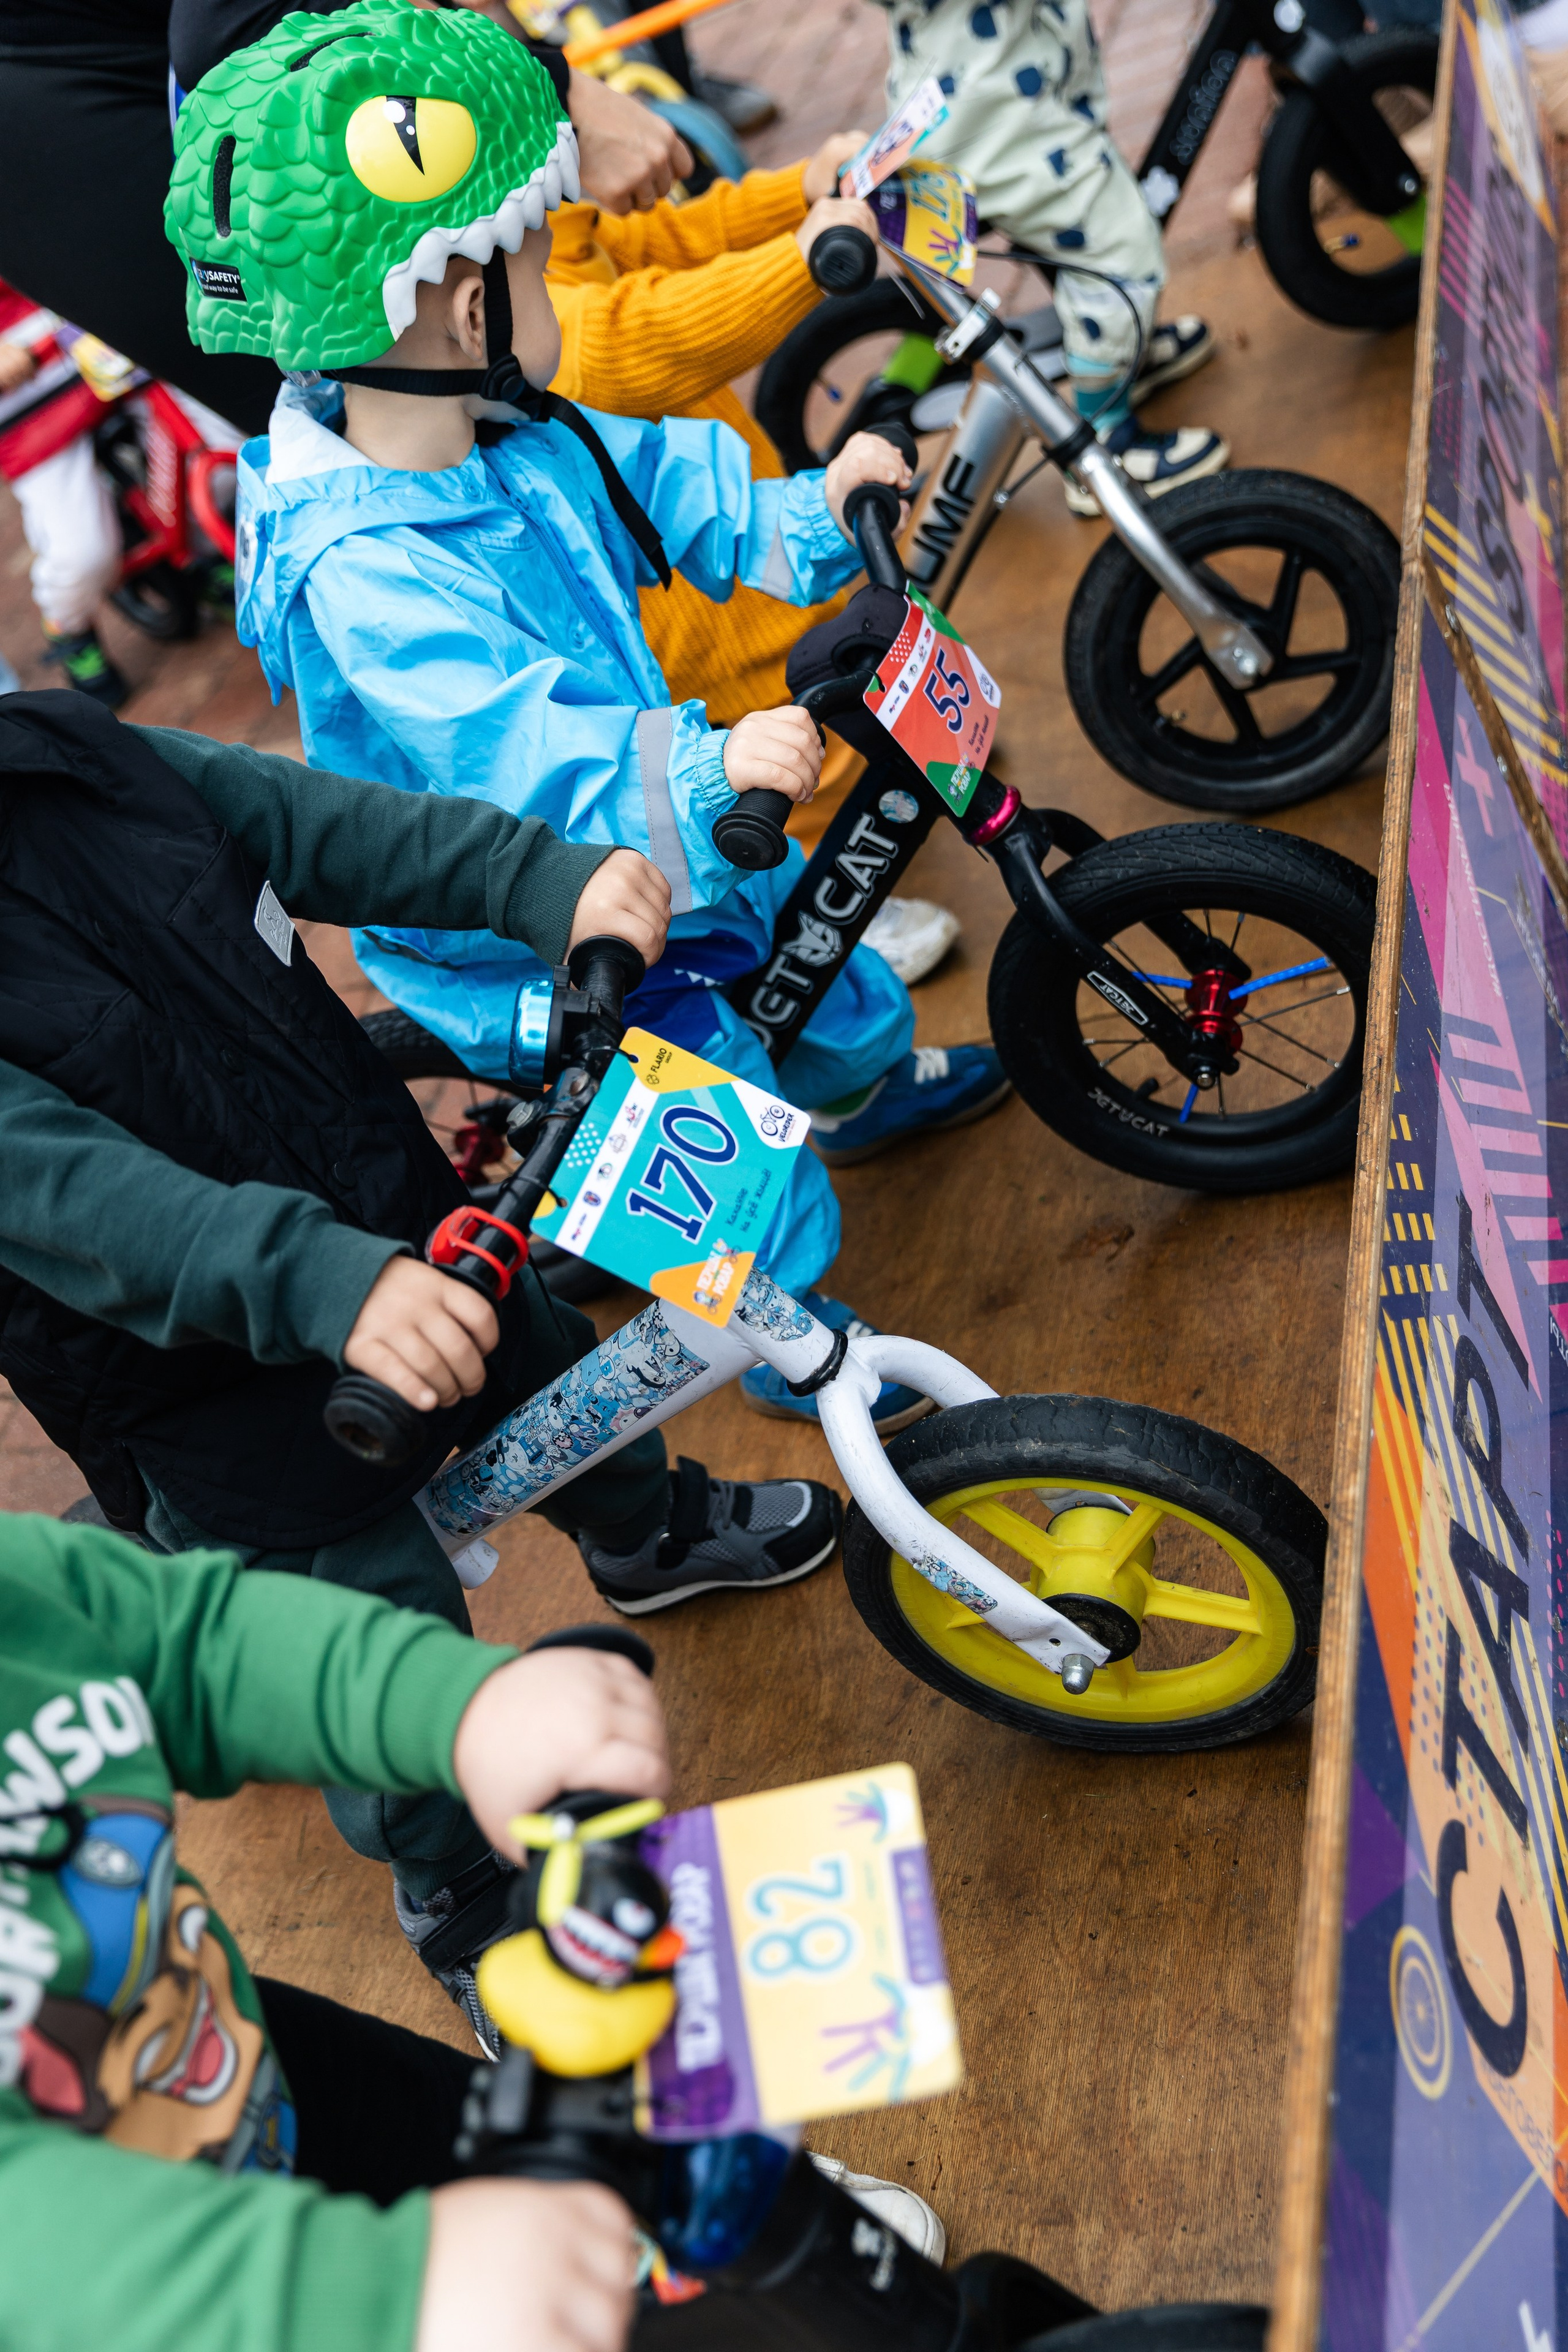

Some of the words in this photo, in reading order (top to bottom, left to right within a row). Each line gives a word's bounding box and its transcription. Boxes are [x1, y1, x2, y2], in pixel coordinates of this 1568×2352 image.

[923, 647, 970, 734] 55
[650, 1047, 667, 1074] FLARIO
[627, 1105, 738, 1243] 170
[778, 1112, 794, 1143] VELORIDER
[1438, 1190, 1529, 2079] СТАРТ
[748, 1858, 855, 1978] 82
